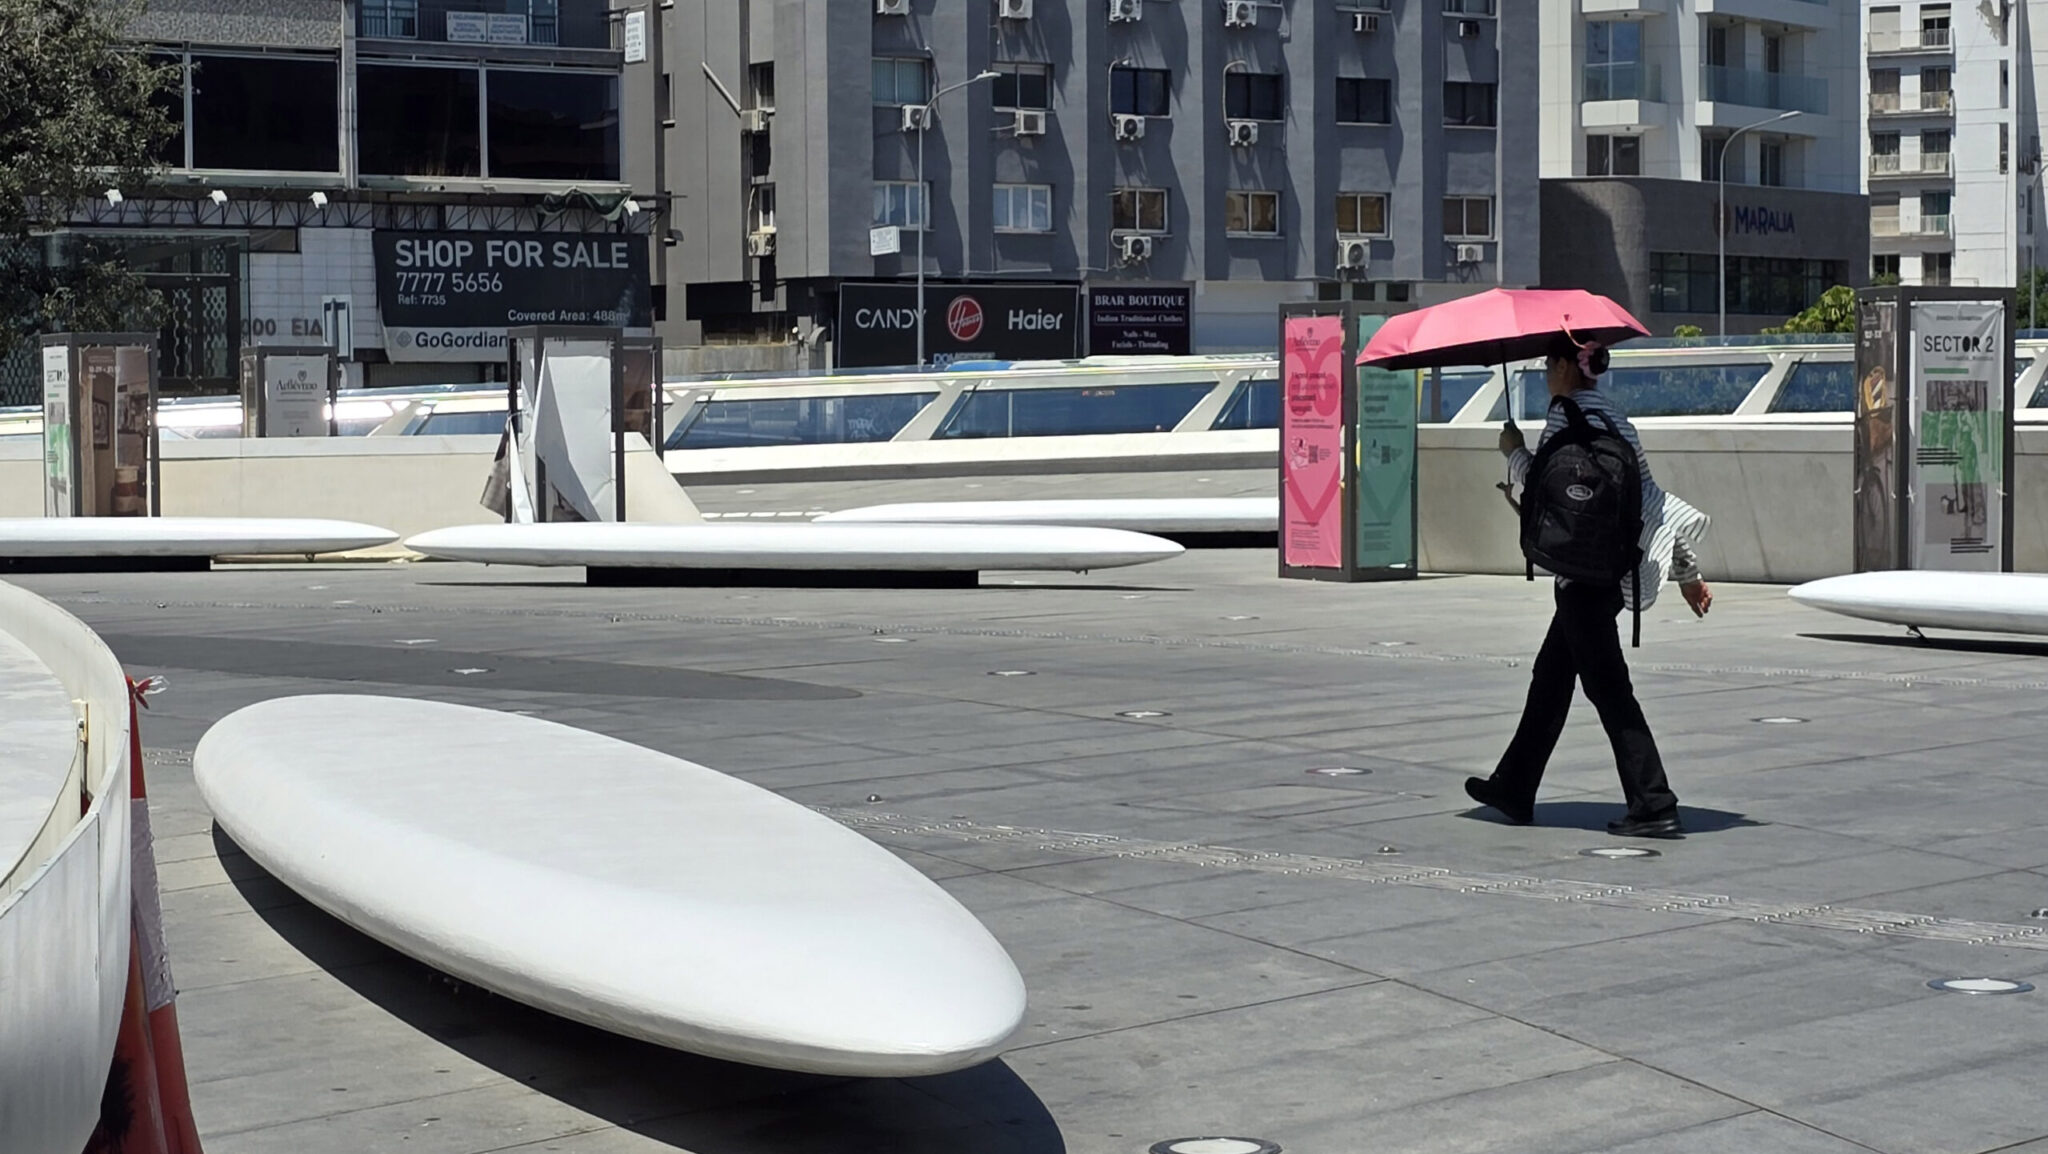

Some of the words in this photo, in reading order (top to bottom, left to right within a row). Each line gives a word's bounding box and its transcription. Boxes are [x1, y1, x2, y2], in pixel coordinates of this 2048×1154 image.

[395, 239, 474, 268] SHOP
[486, 240, 545, 268] FOR
[552, 241, 629, 269] SALE
[396, 272, 446, 293] 7777
[452, 272, 503, 293] 5656
[398, 294, 418, 306] Ref:
[420, 294, 447, 306] 7735
[1095, 295, 1125, 307] BRAR
[1128, 295, 1185, 308] BOUTIQUE
[508, 309, 556, 322] Covered
[559, 309, 591, 322] Area:
[1008, 309, 1063, 331] Haier
[1923, 335, 1981, 353] SECTOR
[1985, 335, 1994, 353] 2
